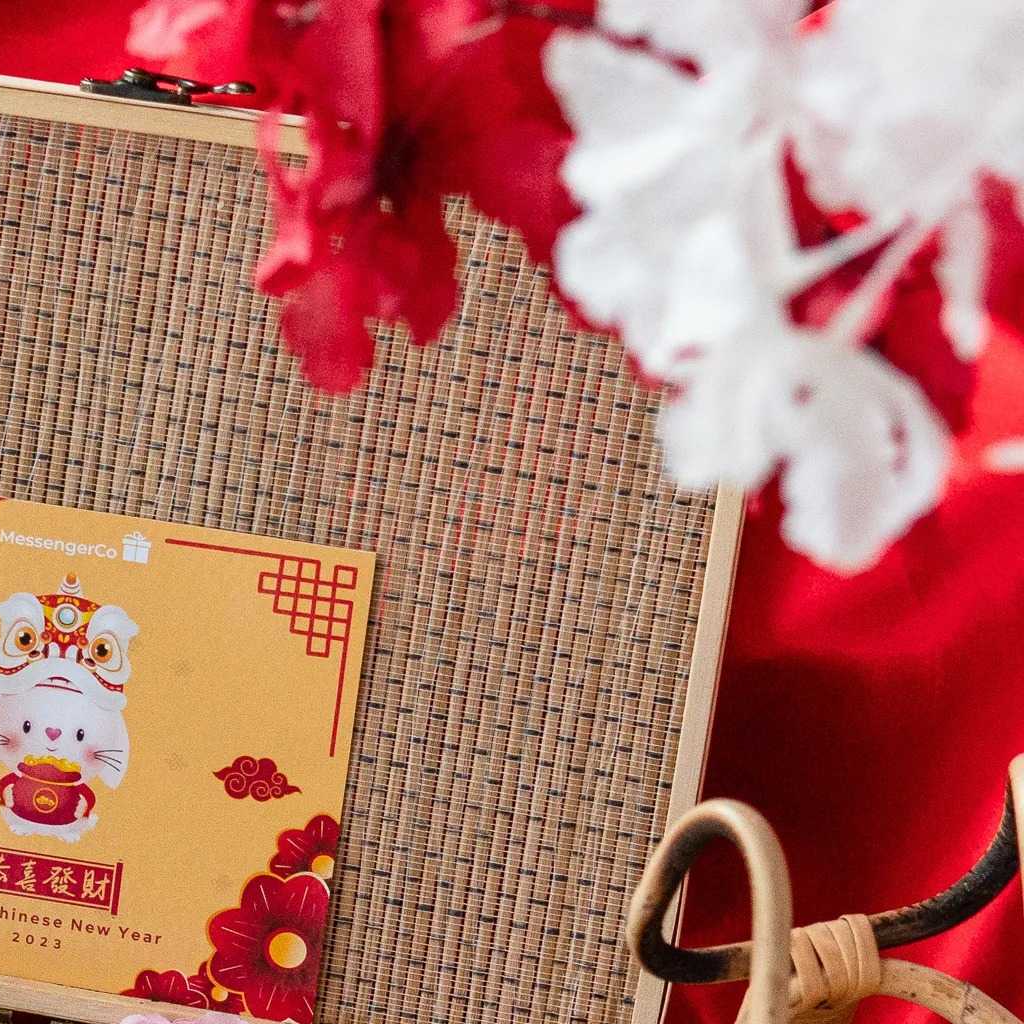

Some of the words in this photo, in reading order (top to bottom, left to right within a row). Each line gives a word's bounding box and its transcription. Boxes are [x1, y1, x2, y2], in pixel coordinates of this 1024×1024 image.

[0, 529, 118, 559] MessengerCo
[11, 932, 62, 950] 2023
[70, 918, 111, 937] New
[118, 926, 162, 945] Year
